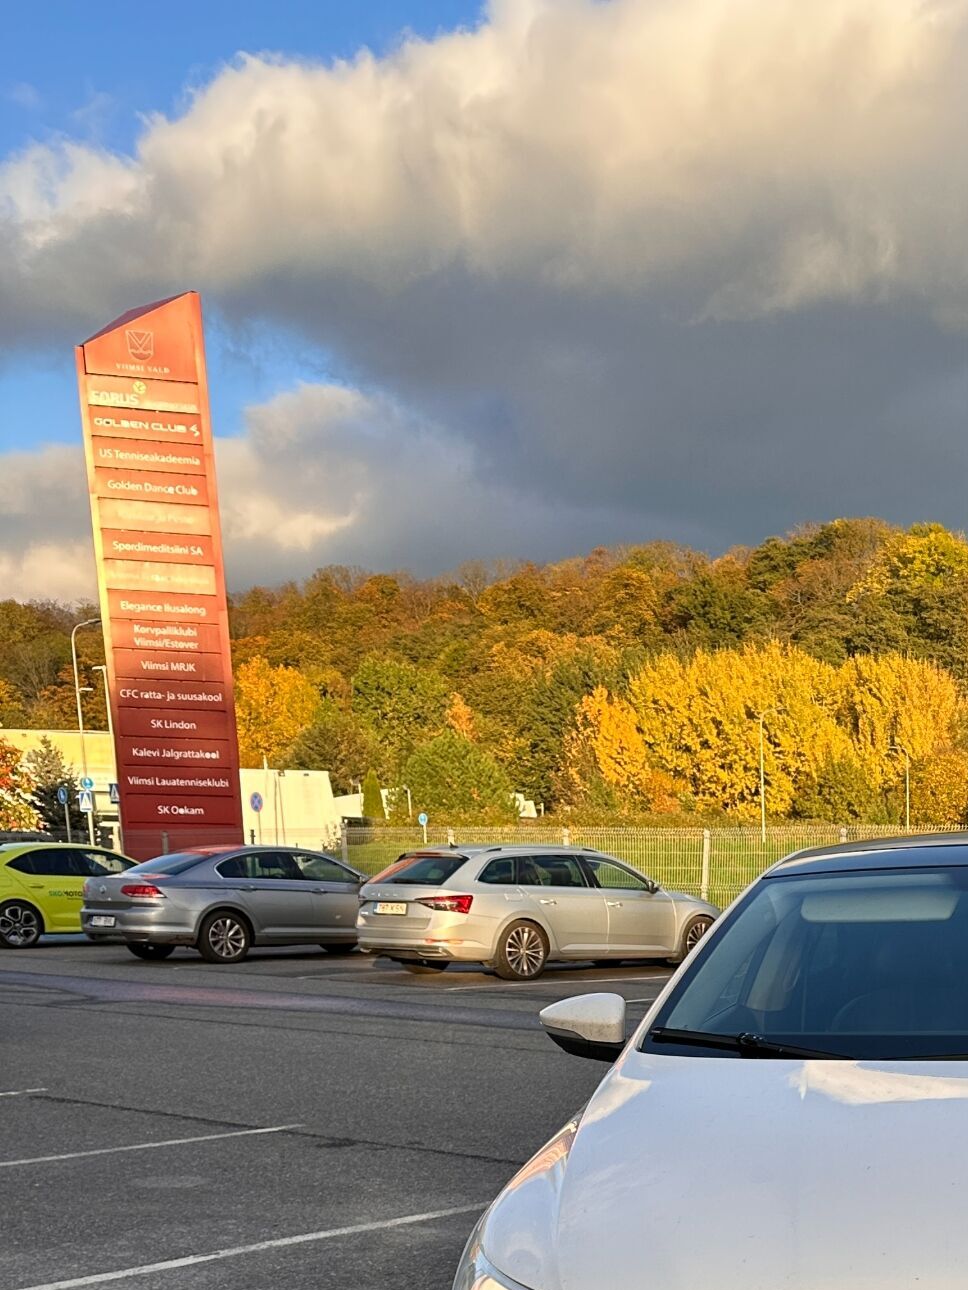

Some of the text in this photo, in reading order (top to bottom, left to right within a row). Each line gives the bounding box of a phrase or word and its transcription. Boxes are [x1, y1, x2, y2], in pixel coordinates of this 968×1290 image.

[94, 417, 187, 433] GOLDEN CLUB
[99, 448, 200, 465] US Tenniseakadeemia
[107, 480, 198, 496] Golden Dance Club
[112, 541, 203, 556] Spordimeditsiini SA
[120, 600, 206, 617] Elegance Ilusalong
[133, 624, 197, 636] Korvpalliklubi
[133, 637, 199, 649] Viimsi/Estover
[140, 660, 196, 672] Viimsi MRJK
[120, 689, 222, 702] CFC ratta- ja suusakool
[150, 719, 197, 729] SK Lindon
[132, 747, 220, 760] Kalevi Jalgrattakool
[127, 776, 229, 788] Viimsi Lauatenniseklubi
[157, 805, 170, 815] SK
